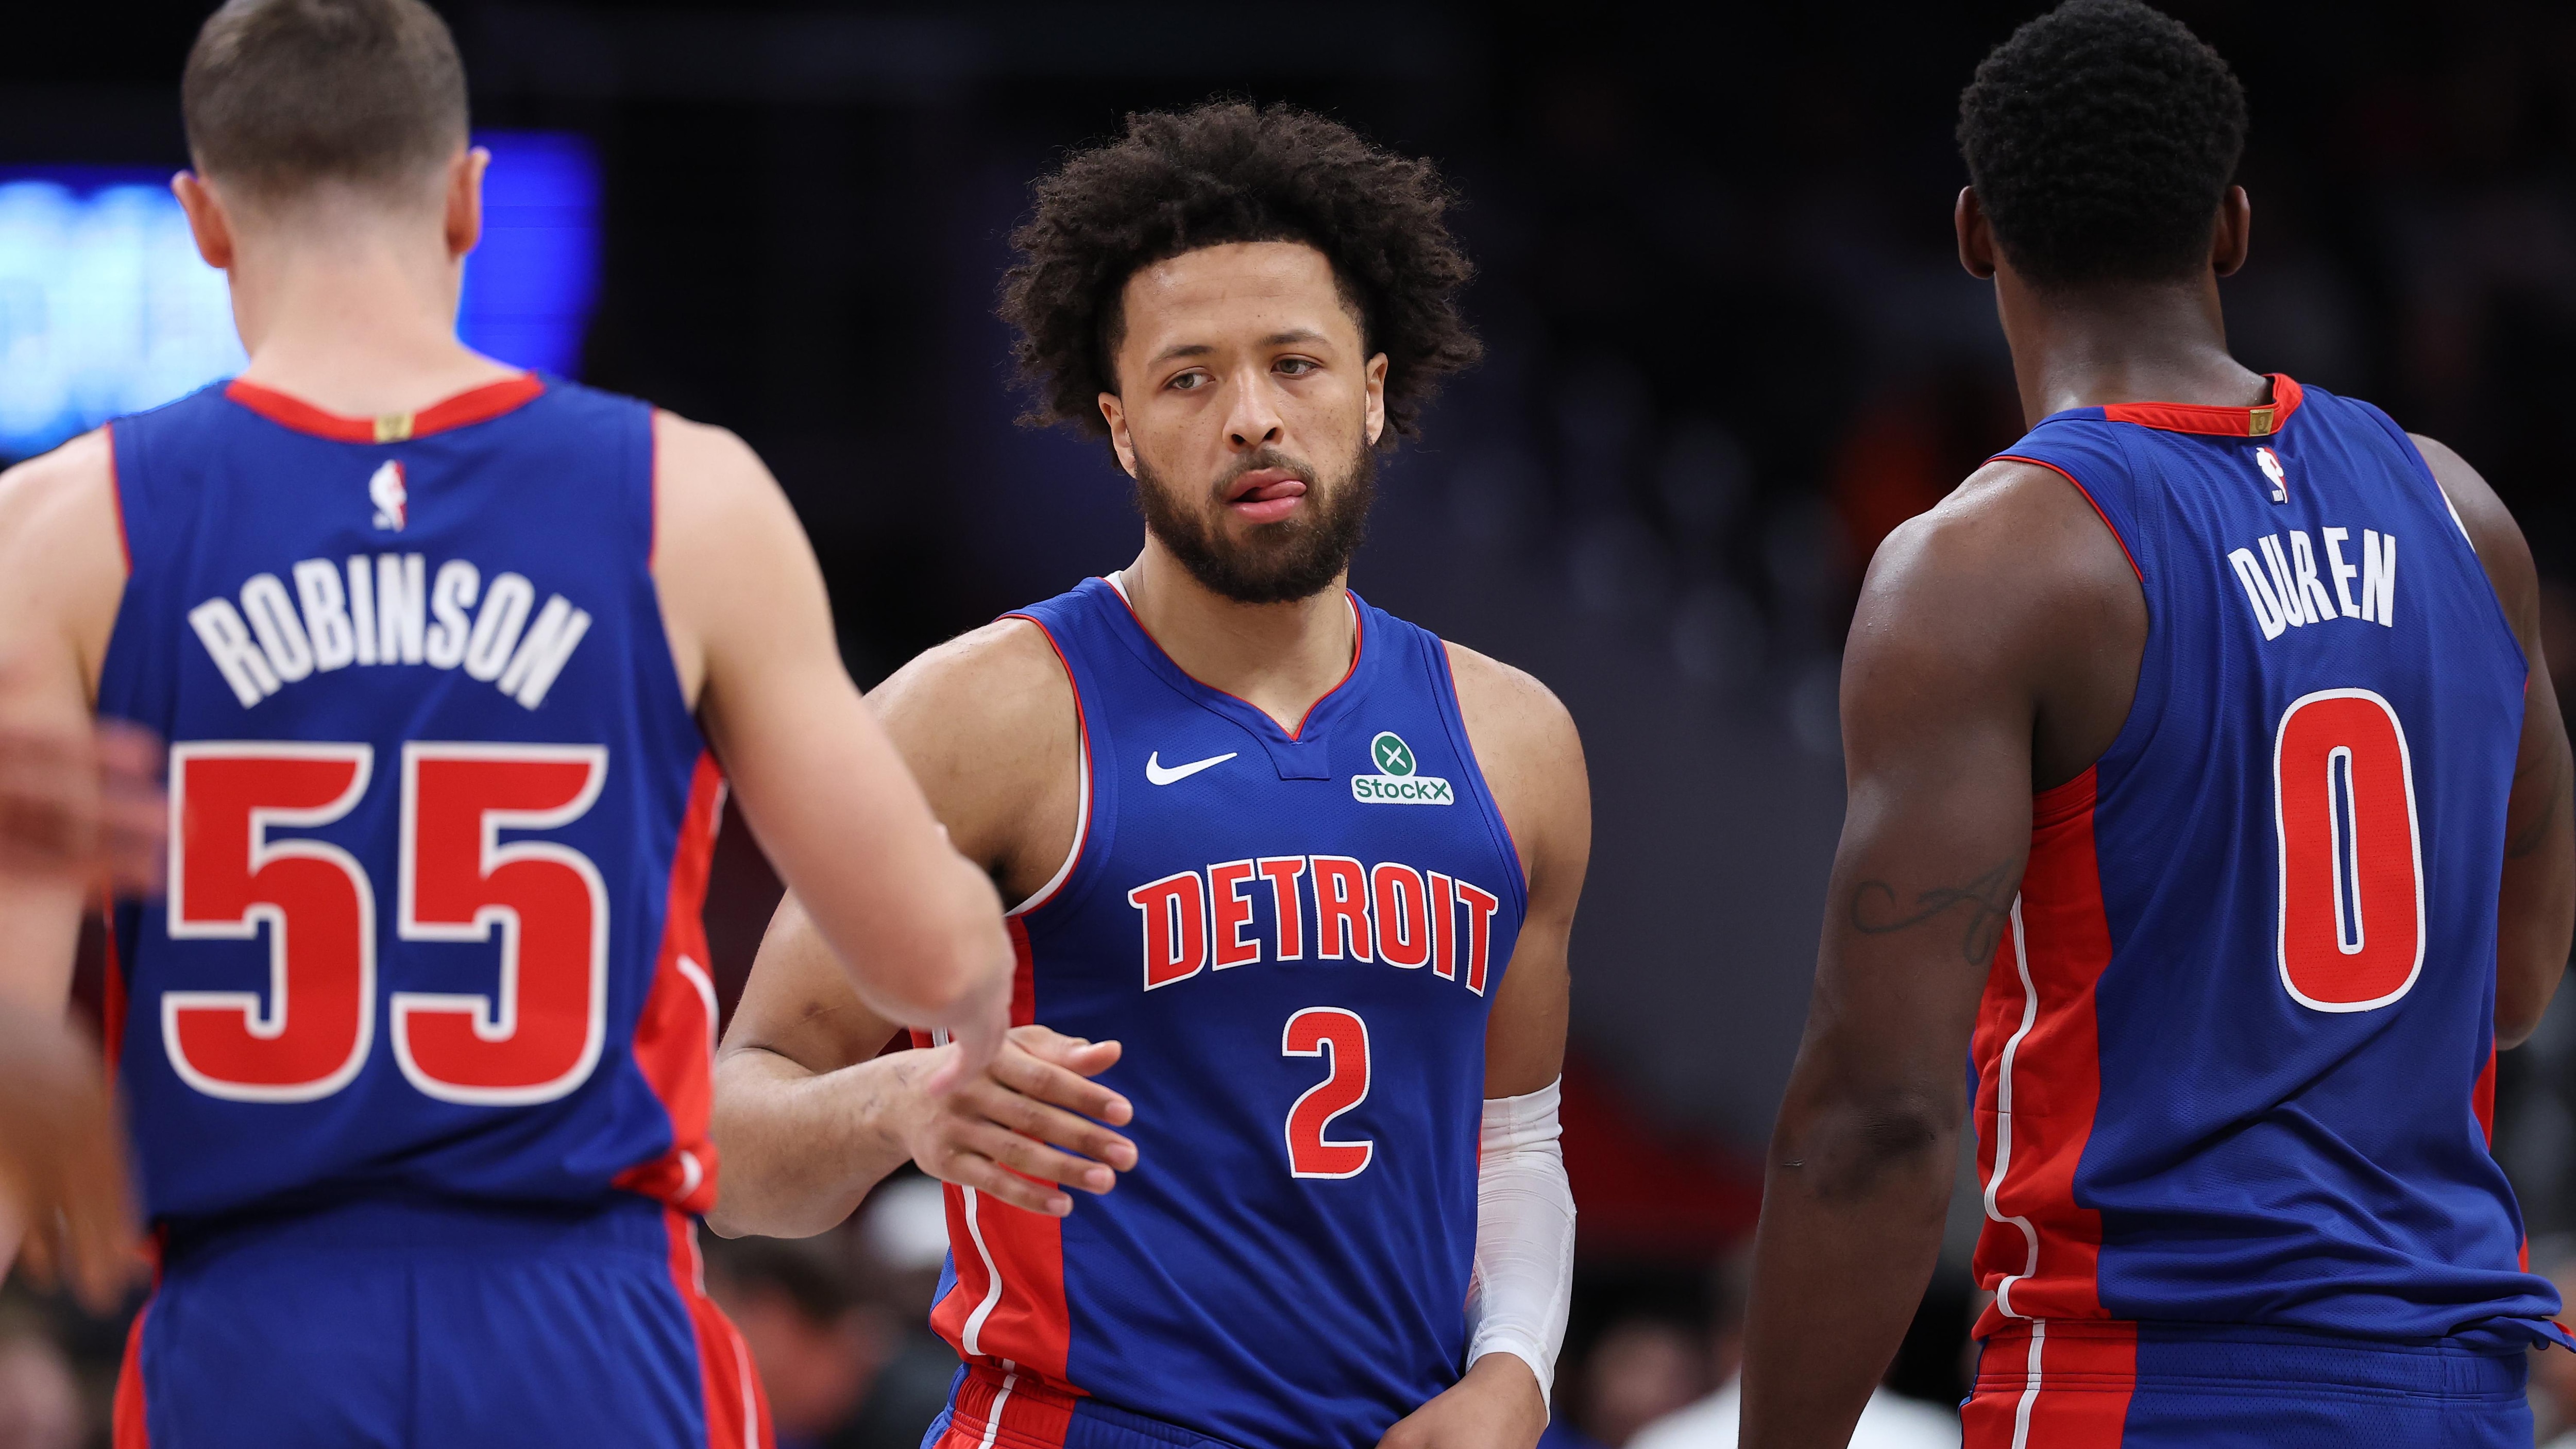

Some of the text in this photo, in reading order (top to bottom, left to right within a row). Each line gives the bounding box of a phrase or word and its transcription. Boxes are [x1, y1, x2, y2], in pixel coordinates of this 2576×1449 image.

[188, 552, 592, 711] ROBINSON
[2227, 526, 2396, 642] DUREN
[1355, 778, 1450, 801] StockX
[2273, 687, 2426, 1013] 0
[161, 740, 610, 1106] 55
[1128, 855, 1499, 997] DETROIT
[1282, 1007, 1373, 1180] 2
